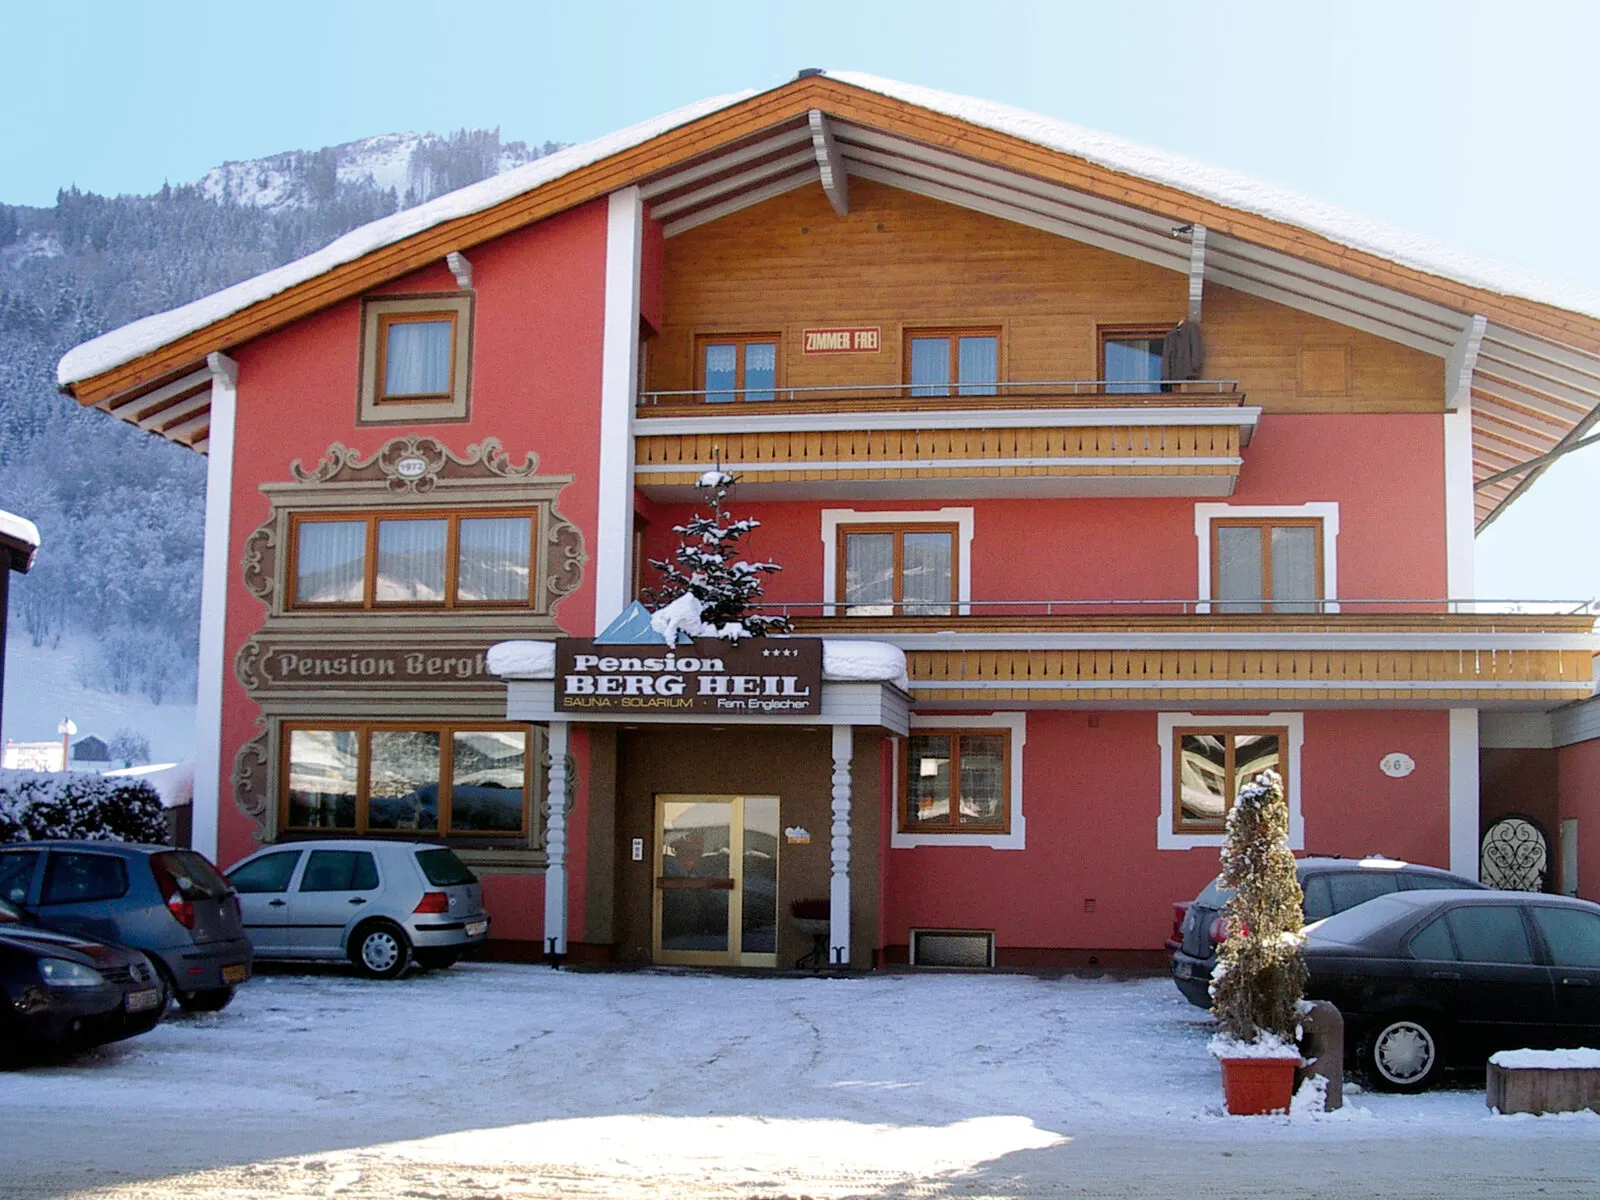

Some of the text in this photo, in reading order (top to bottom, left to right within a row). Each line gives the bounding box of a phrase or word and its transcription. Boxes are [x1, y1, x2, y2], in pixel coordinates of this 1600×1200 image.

[806, 331, 878, 350] ZIMMER FREI
[277, 652, 489, 678] Pension Bergh
[574, 652, 725, 672] Pension
[564, 674, 810, 696] BERG HEIL
[563, 697, 693, 708] SAUNA SOLARIUM
[1393, 759, 1401, 771] 6
